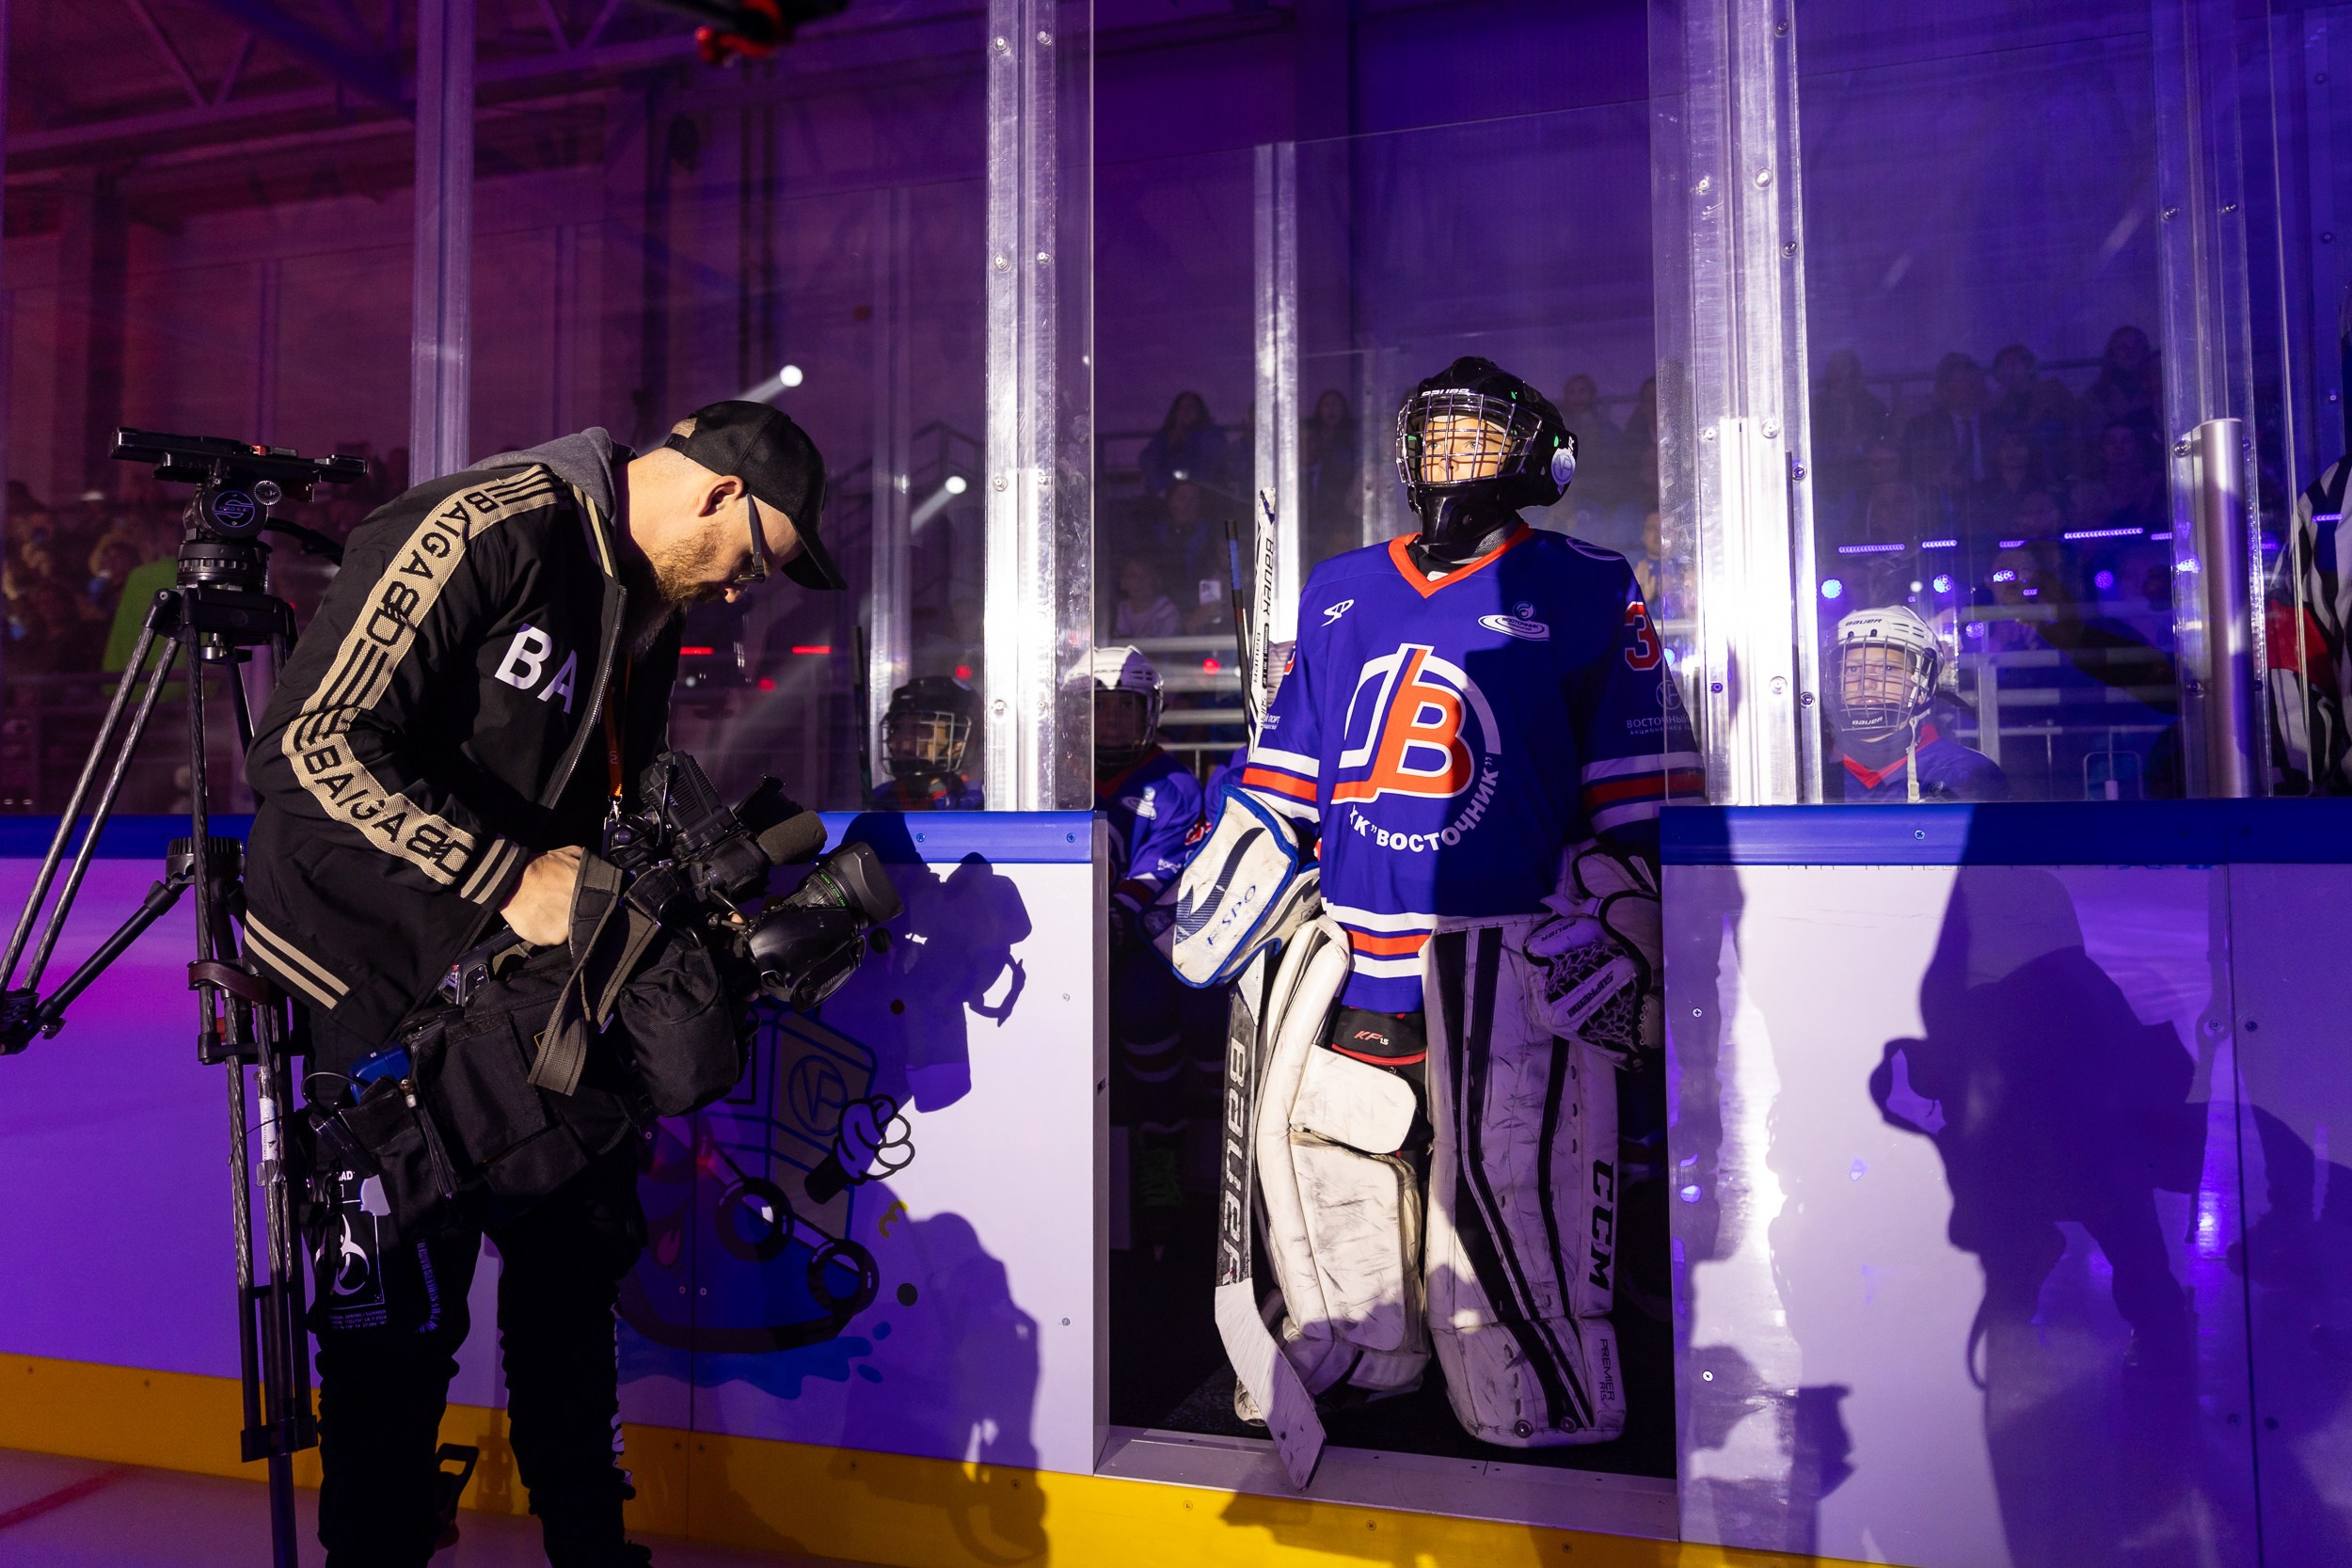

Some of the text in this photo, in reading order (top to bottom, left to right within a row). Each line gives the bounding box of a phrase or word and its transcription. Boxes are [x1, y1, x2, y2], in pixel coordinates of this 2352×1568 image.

[1845, 618, 1883, 627] BAUER
[1851, 716, 1883, 725] BAUER
[1566, 971, 1614, 1018] SUPREME
[1222, 1036, 1248, 1285] BAUER
[1589, 1159, 1615, 1291] CCM
[1599, 1338, 1615, 1402] PREMIER
